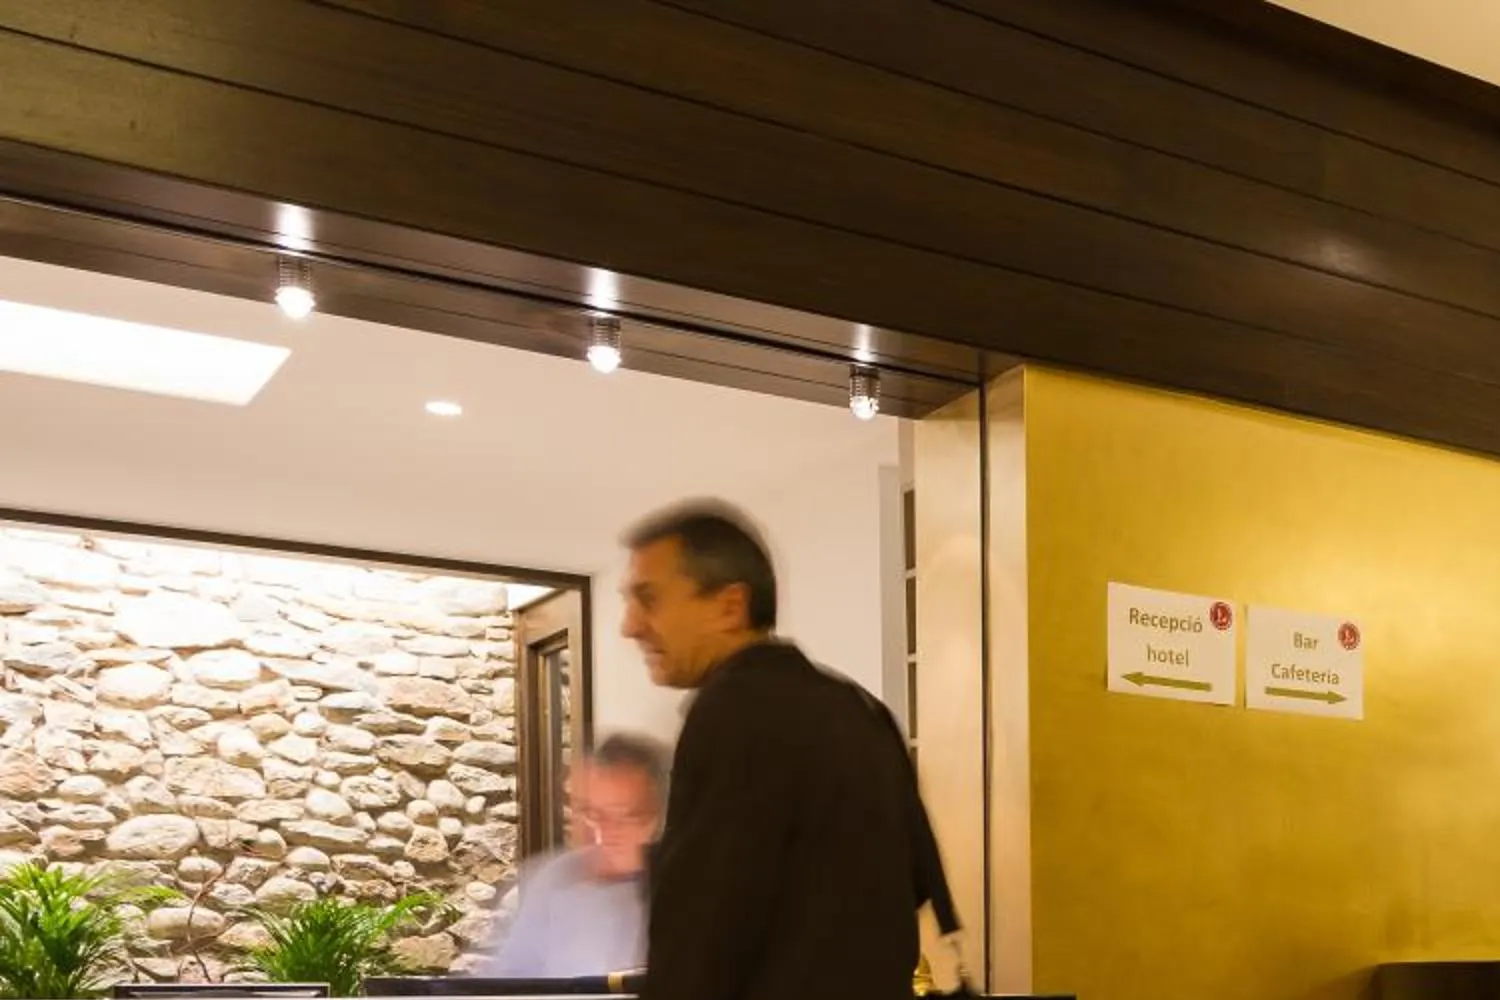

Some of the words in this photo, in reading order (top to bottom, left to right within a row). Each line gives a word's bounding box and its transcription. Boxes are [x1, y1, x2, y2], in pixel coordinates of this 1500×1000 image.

[1129, 607, 1203, 633] Recepció
[1293, 631, 1319, 650] Bar
[1146, 643, 1189, 667] hotel
[1271, 663, 1340, 685] Cafeteria
